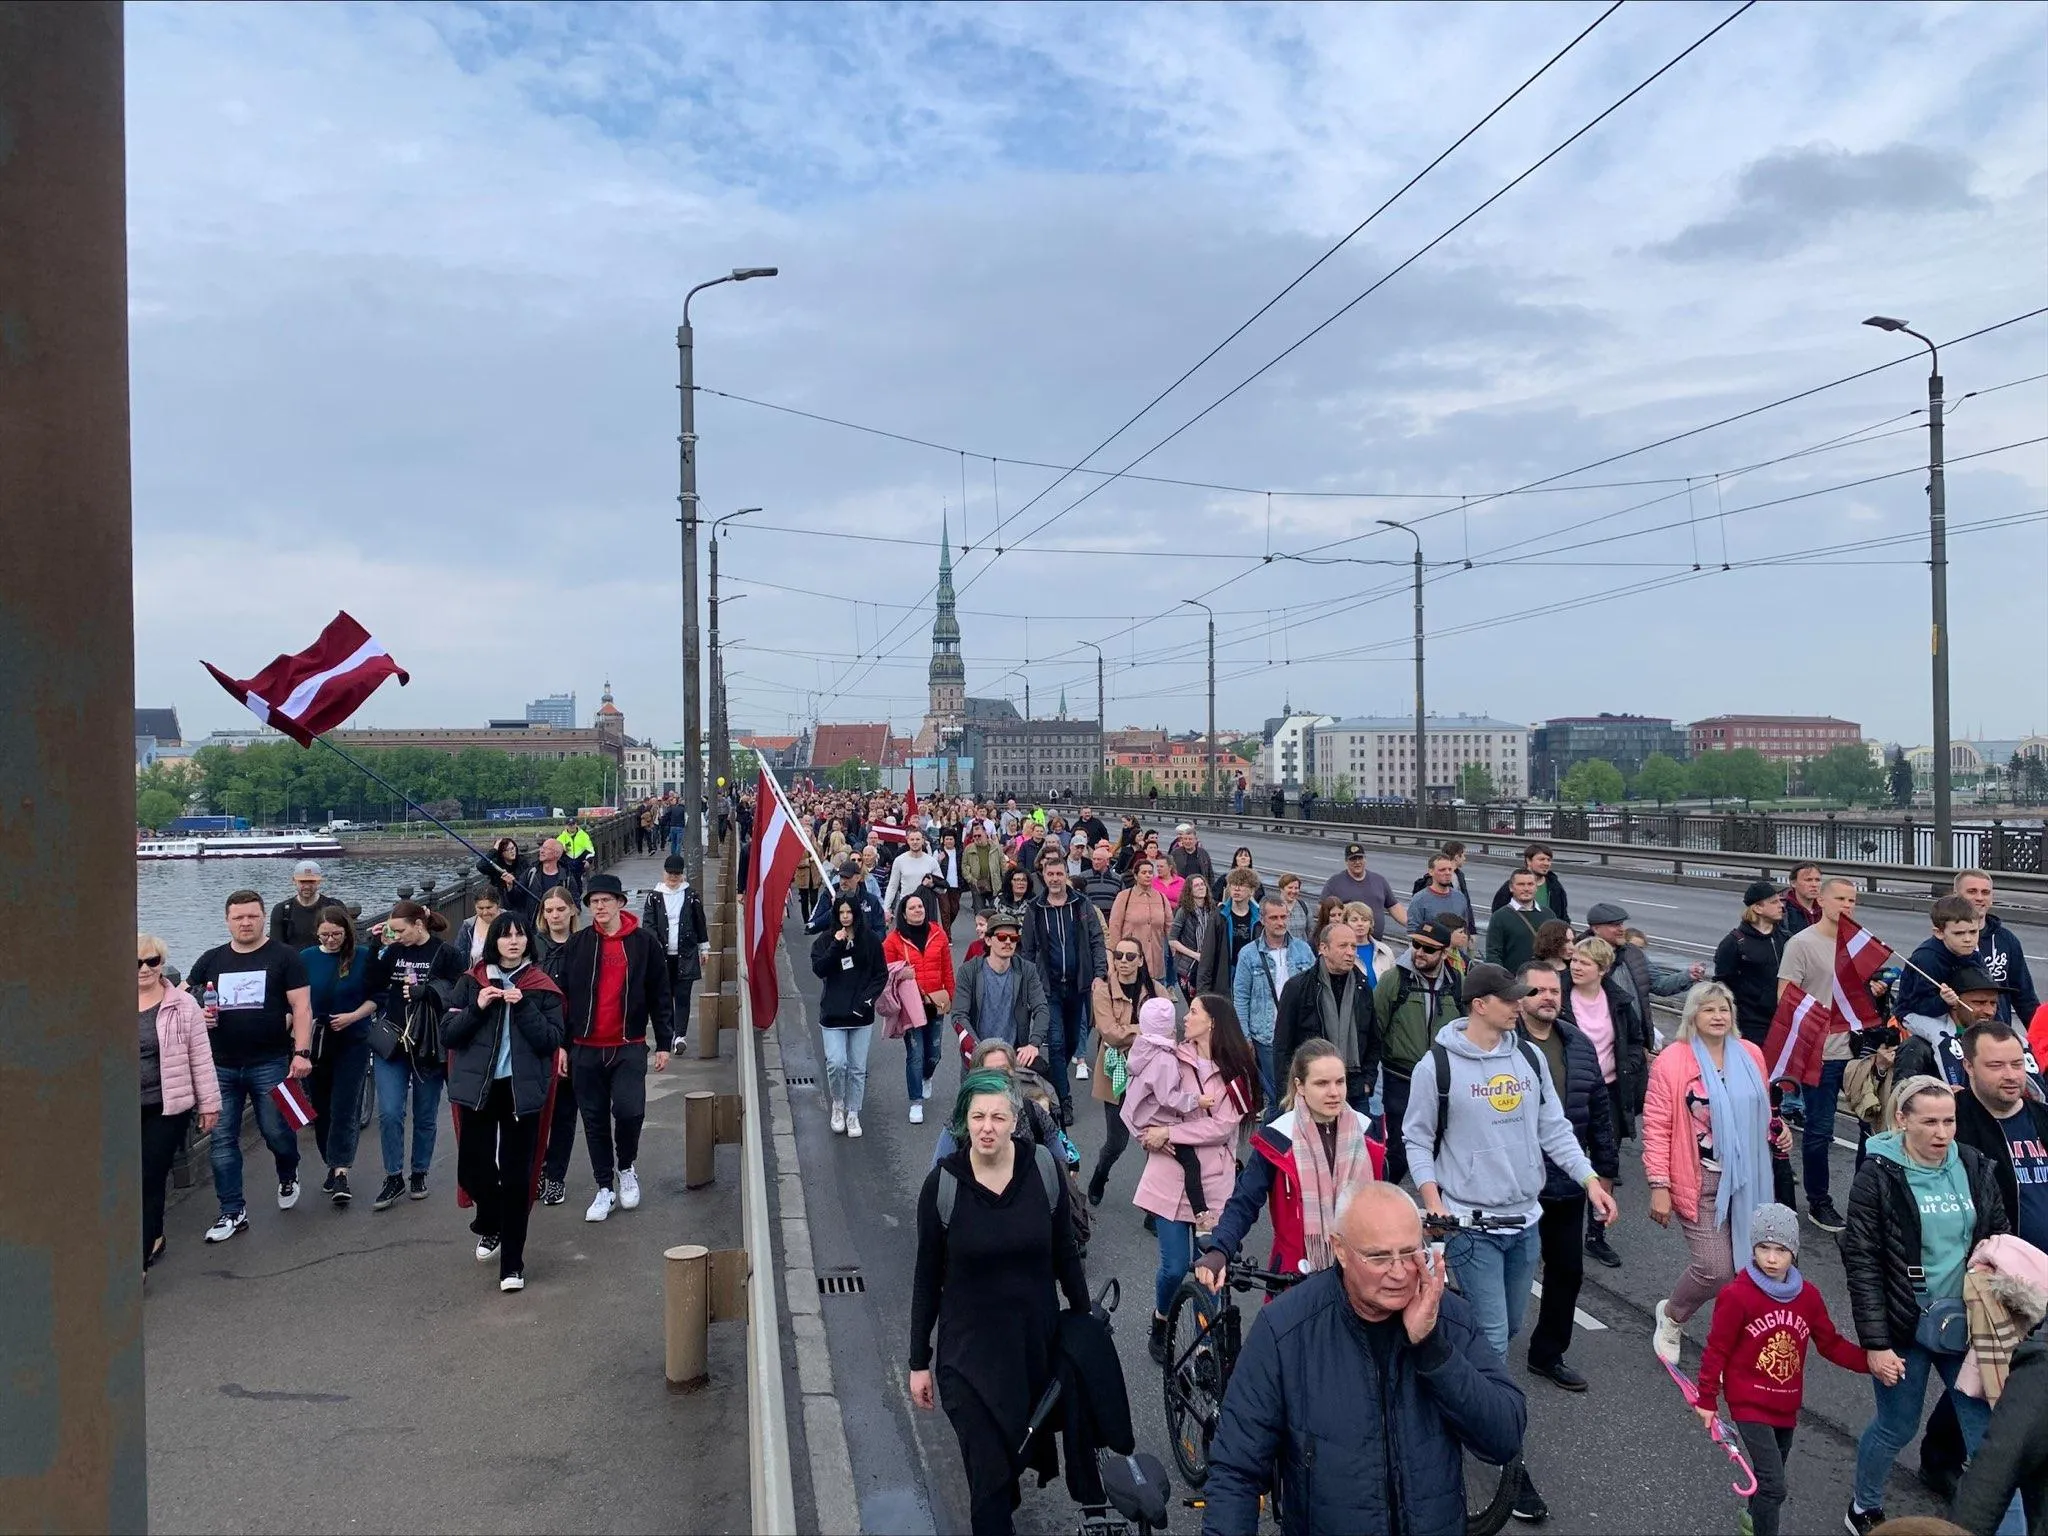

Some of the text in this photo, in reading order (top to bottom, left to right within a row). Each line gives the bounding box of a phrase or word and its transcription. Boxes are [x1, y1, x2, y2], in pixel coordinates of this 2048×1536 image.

[1470, 1076, 1532, 1098] Hard Rock
[1920, 1202, 1937, 1213] ut
[1744, 1308, 1810, 1340] HOGWARTS
